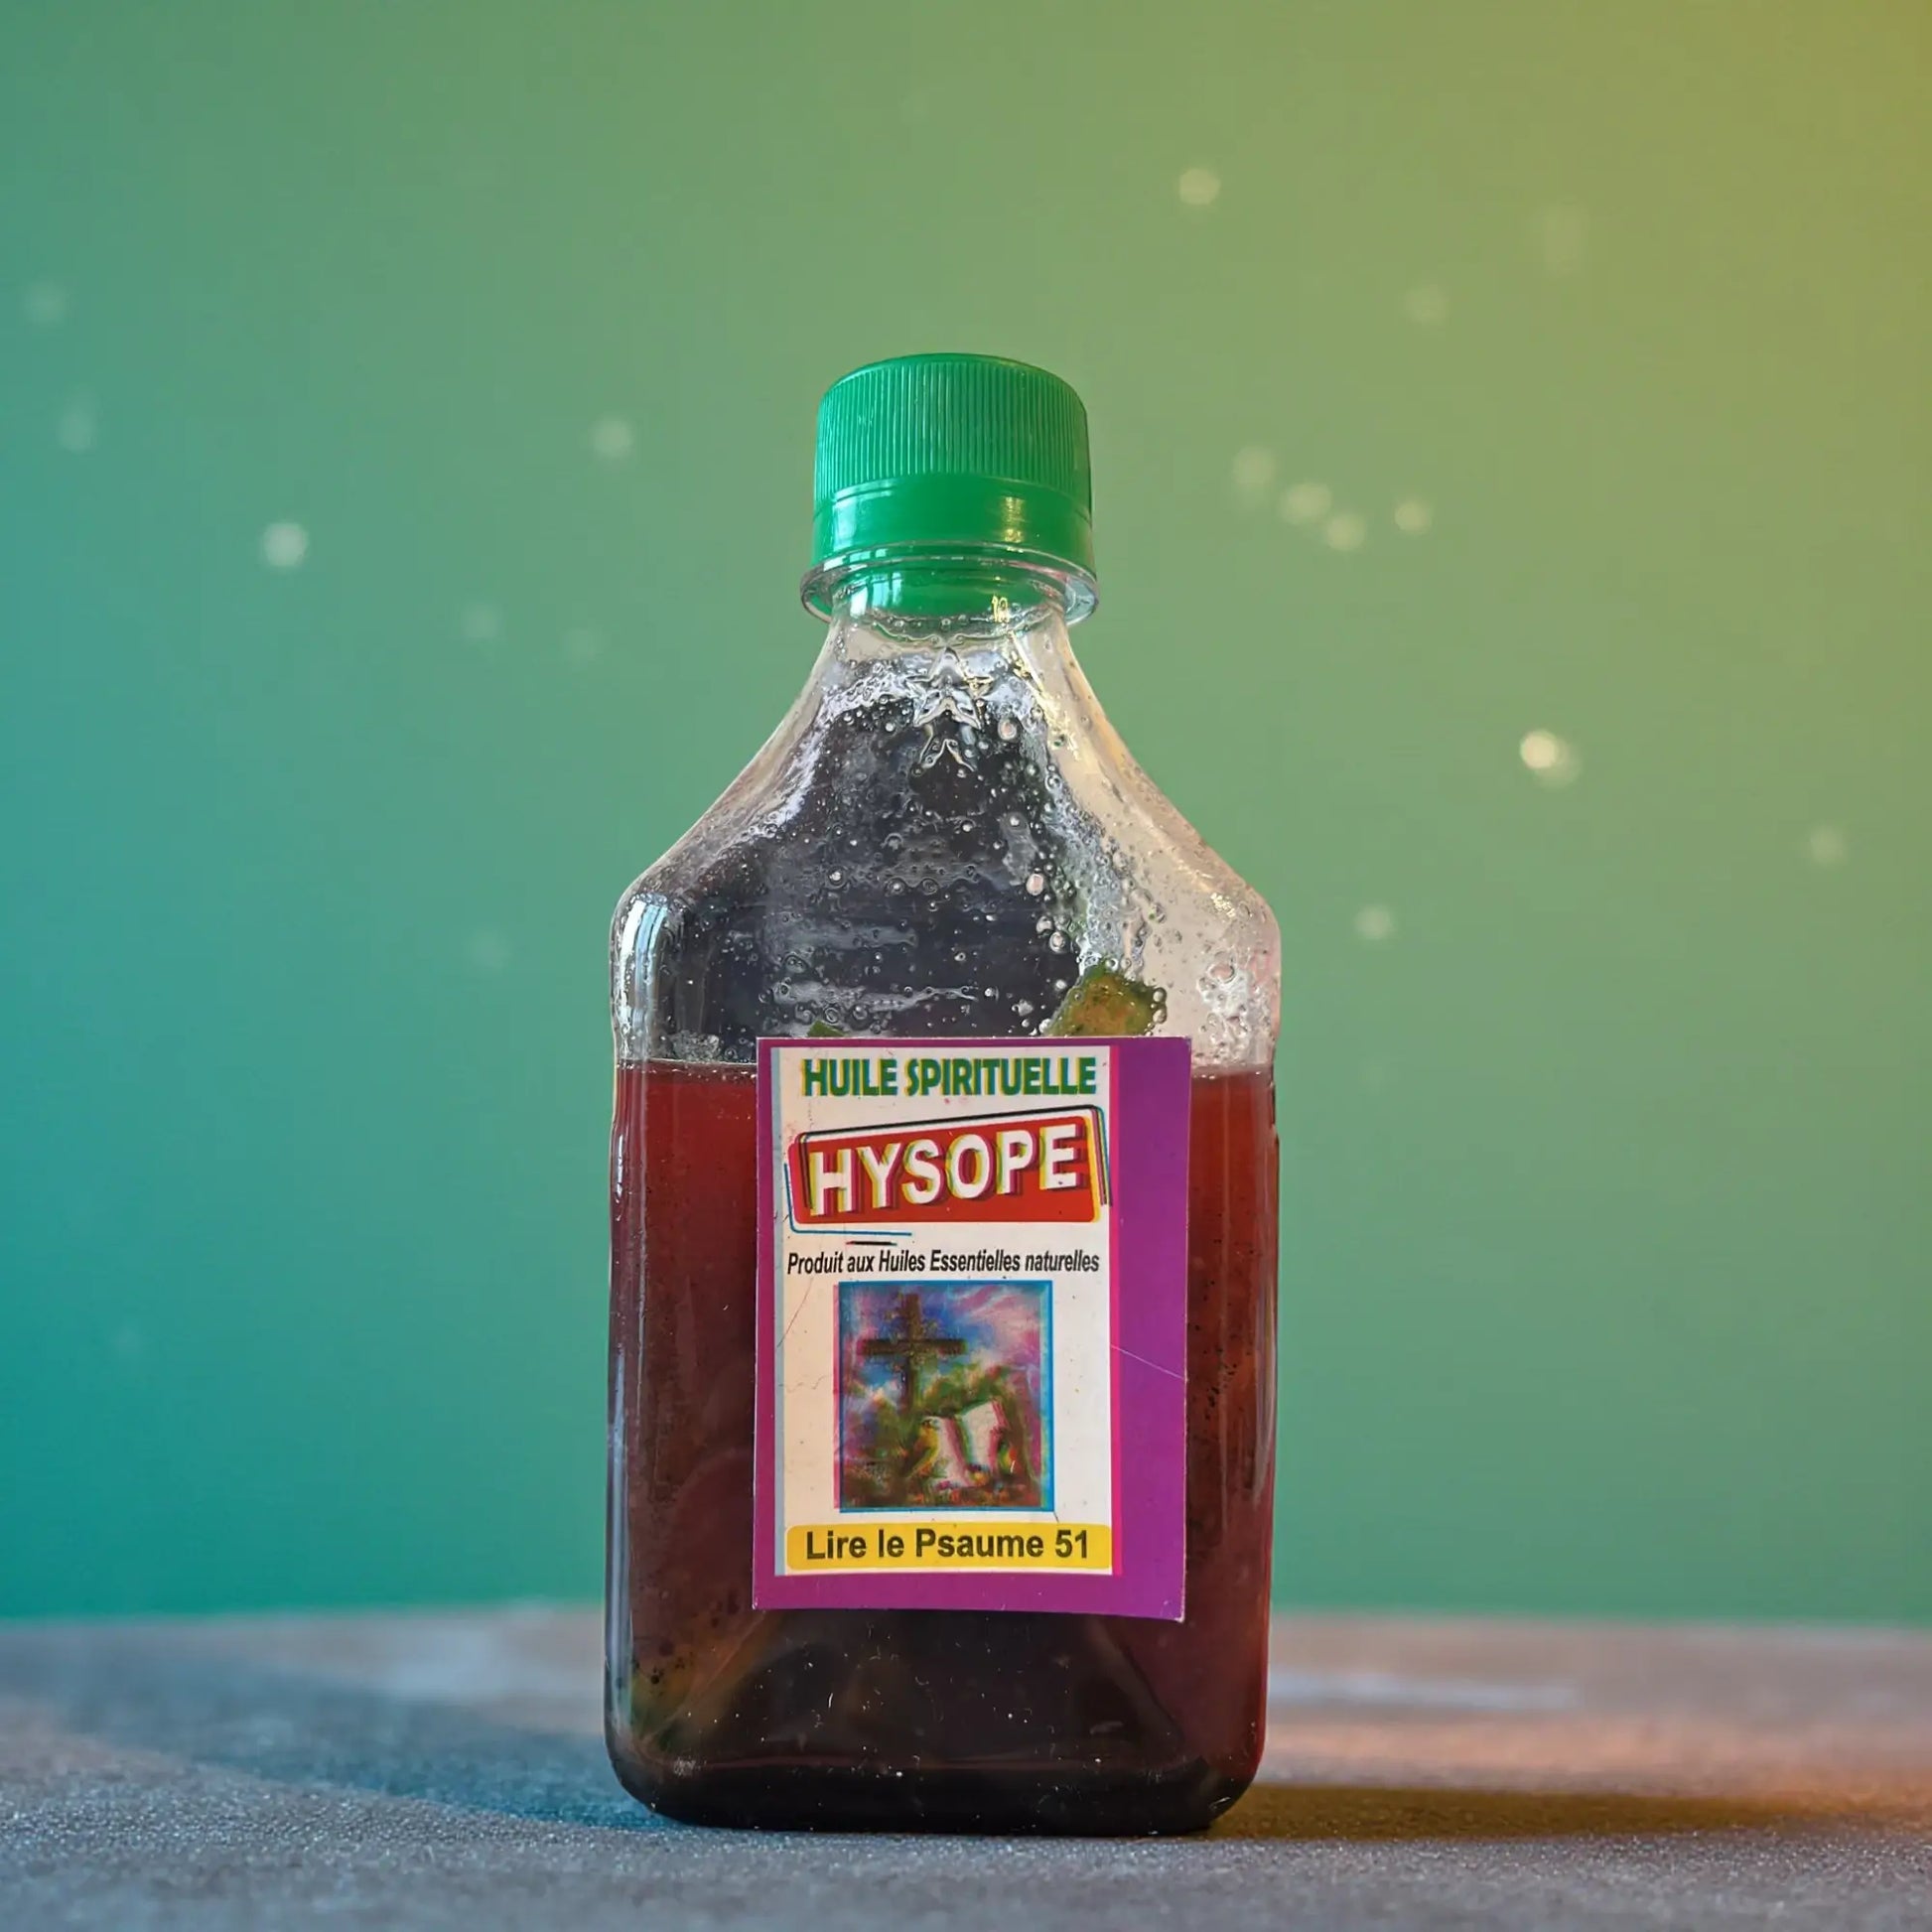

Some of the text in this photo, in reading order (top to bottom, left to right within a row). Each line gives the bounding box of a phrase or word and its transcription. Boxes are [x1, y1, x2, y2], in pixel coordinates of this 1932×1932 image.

[802, 1056, 1097, 1097] HUILE SPIRITUELLE
[809, 1124, 1083, 1216] HYSOPE
[787, 1249, 1100, 1275] Produit aux Huiles Essentielles naturelles
[806, 1528, 1088, 1560] Lire le Psaume 51
